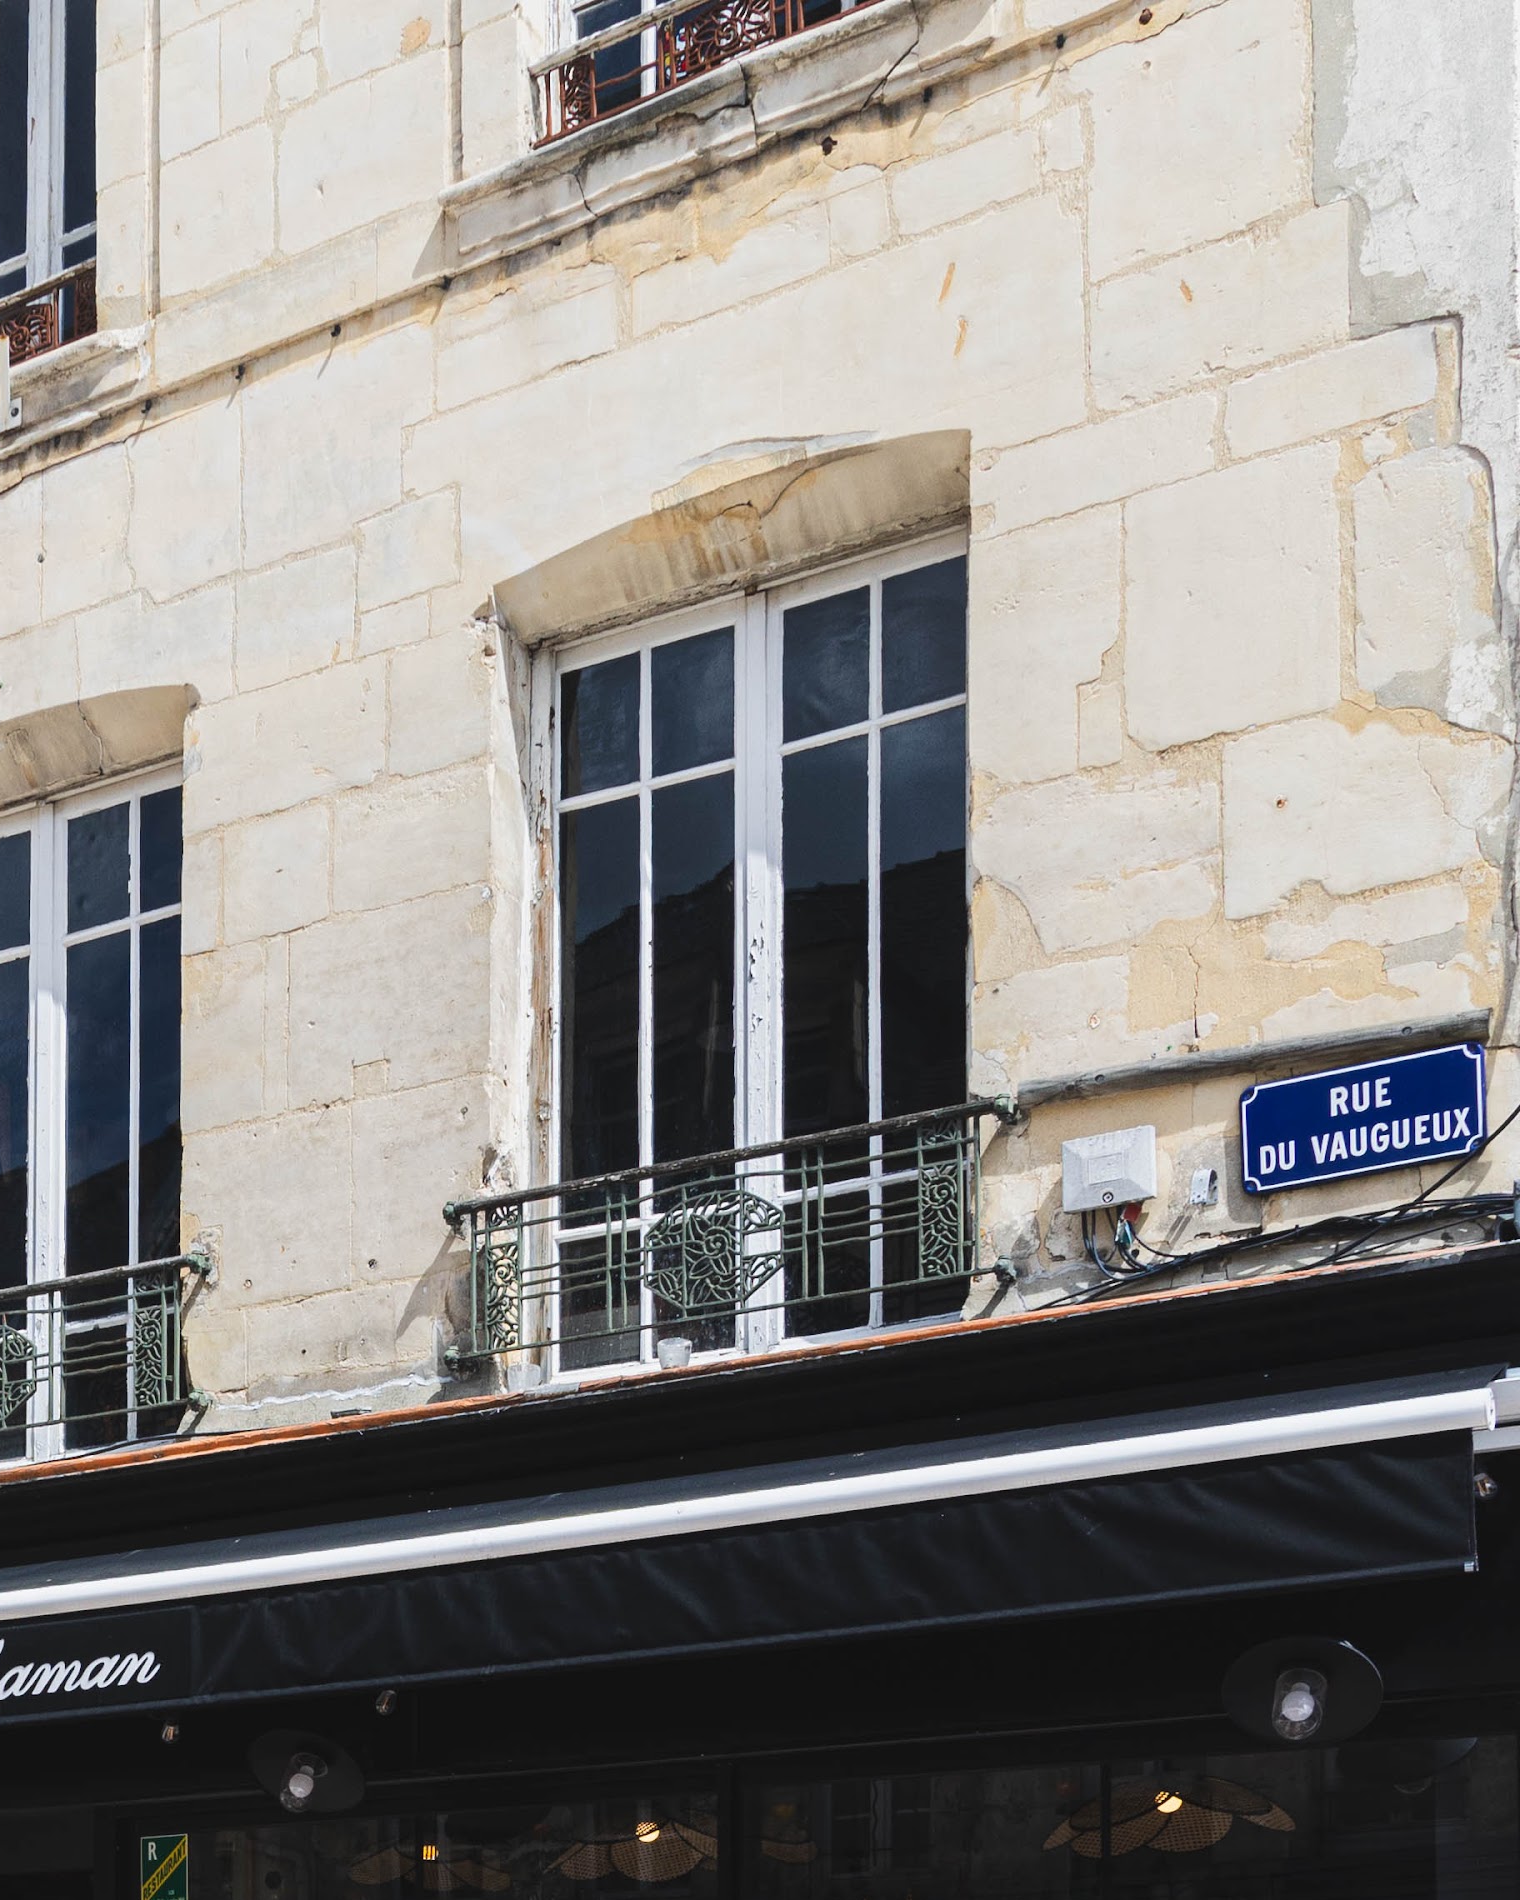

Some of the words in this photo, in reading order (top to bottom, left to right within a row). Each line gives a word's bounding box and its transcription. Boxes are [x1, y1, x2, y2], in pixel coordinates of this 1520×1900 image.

[1329, 1076, 1392, 1117] RUE
[1259, 1140, 1296, 1175] DU
[1311, 1107, 1471, 1164] VAUGUEUX
[147, 1841, 158, 1861] R
